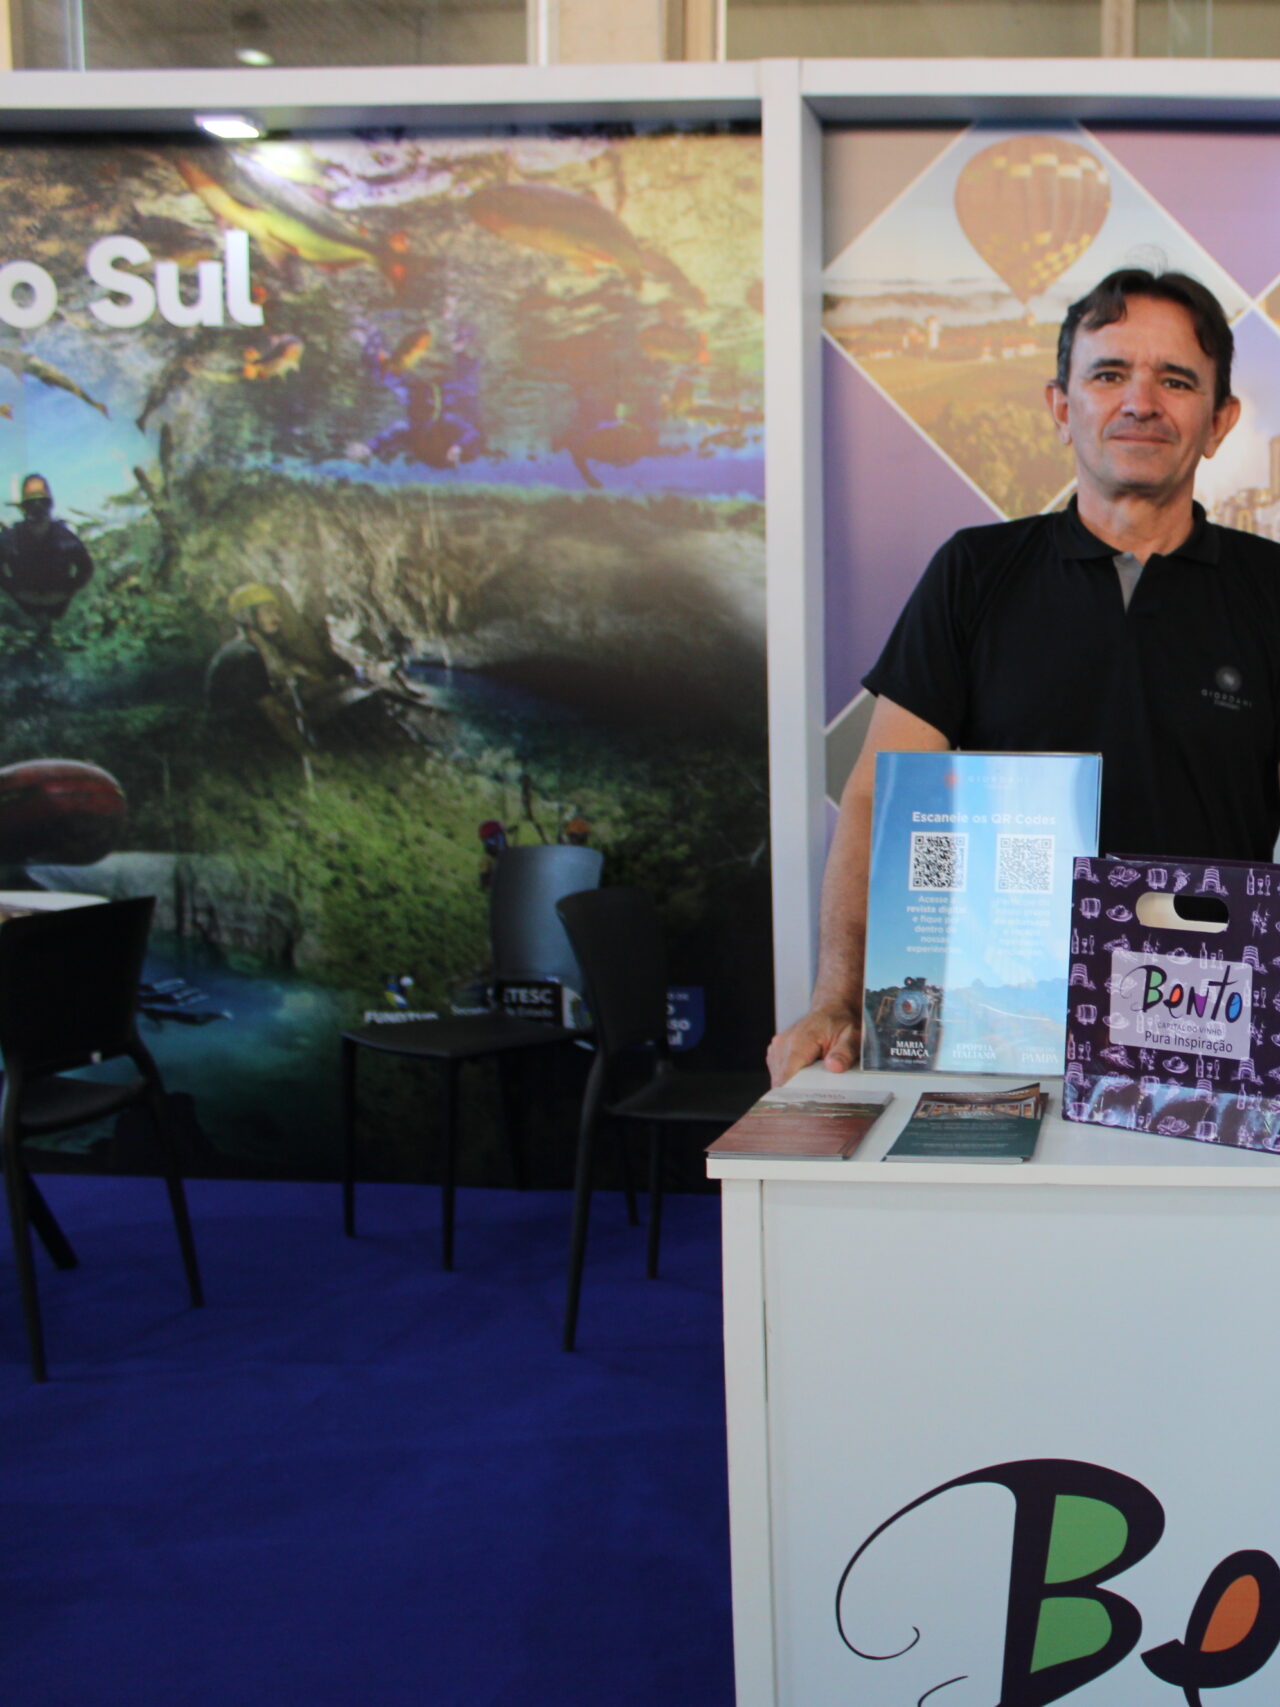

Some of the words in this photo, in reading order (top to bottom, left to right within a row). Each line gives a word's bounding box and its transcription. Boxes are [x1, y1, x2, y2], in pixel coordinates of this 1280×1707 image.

[87, 229, 265, 329] Sul
[912, 811, 969, 824] Escaneie
[972, 815, 988, 825] os
[991, 814, 1011, 826] QR
[1015, 814, 1057, 826] Codes
[1119, 964, 1243, 1024] Bento
[1199, 1026, 1223, 1036] VINHO
[895, 1040, 924, 1049] MARIA
[1145, 1030, 1170, 1046] Pura
[1174, 1031, 1233, 1054] Inspiração
[890, 1047, 930, 1059] FUMAÇA
